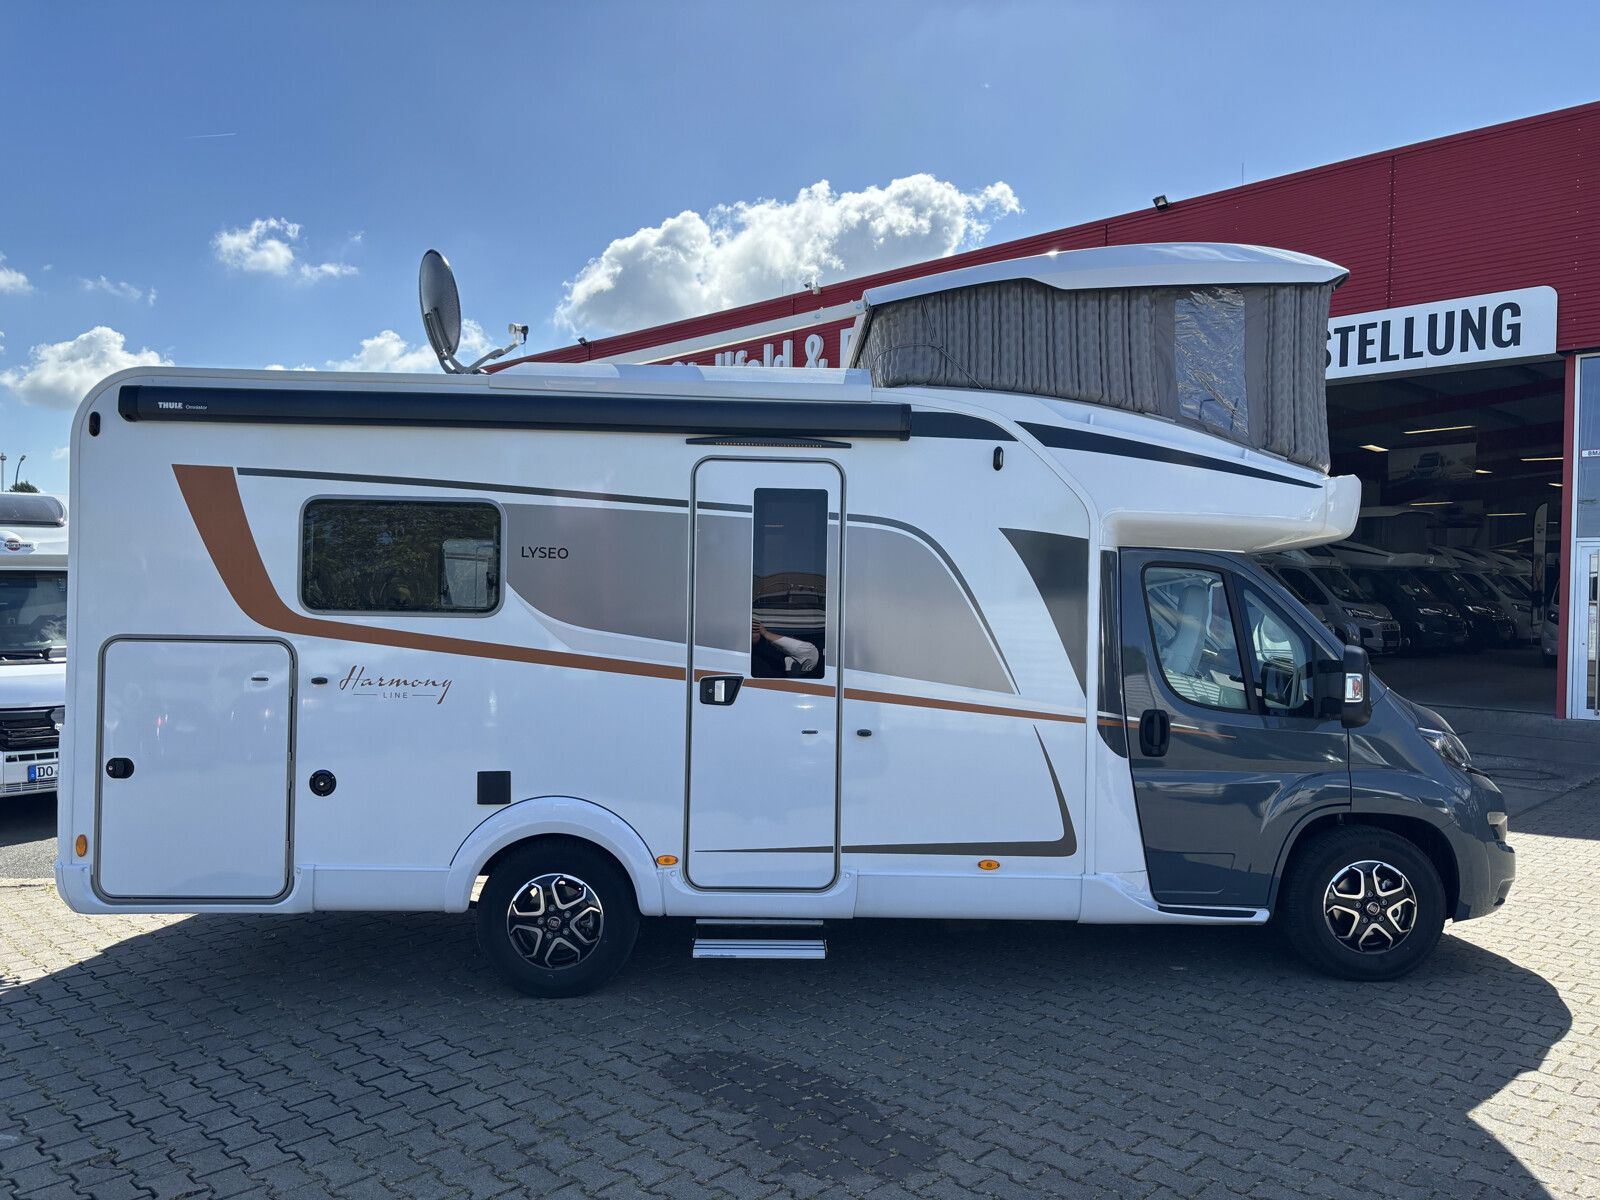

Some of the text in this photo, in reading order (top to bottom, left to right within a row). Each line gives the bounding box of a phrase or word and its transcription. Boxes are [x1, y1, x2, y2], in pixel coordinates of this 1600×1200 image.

[158, 401, 183, 409] THULE
[521, 546, 569, 559] LYSEO
[339, 665, 452, 704] Harmony
[37, 765, 54, 778] DO
